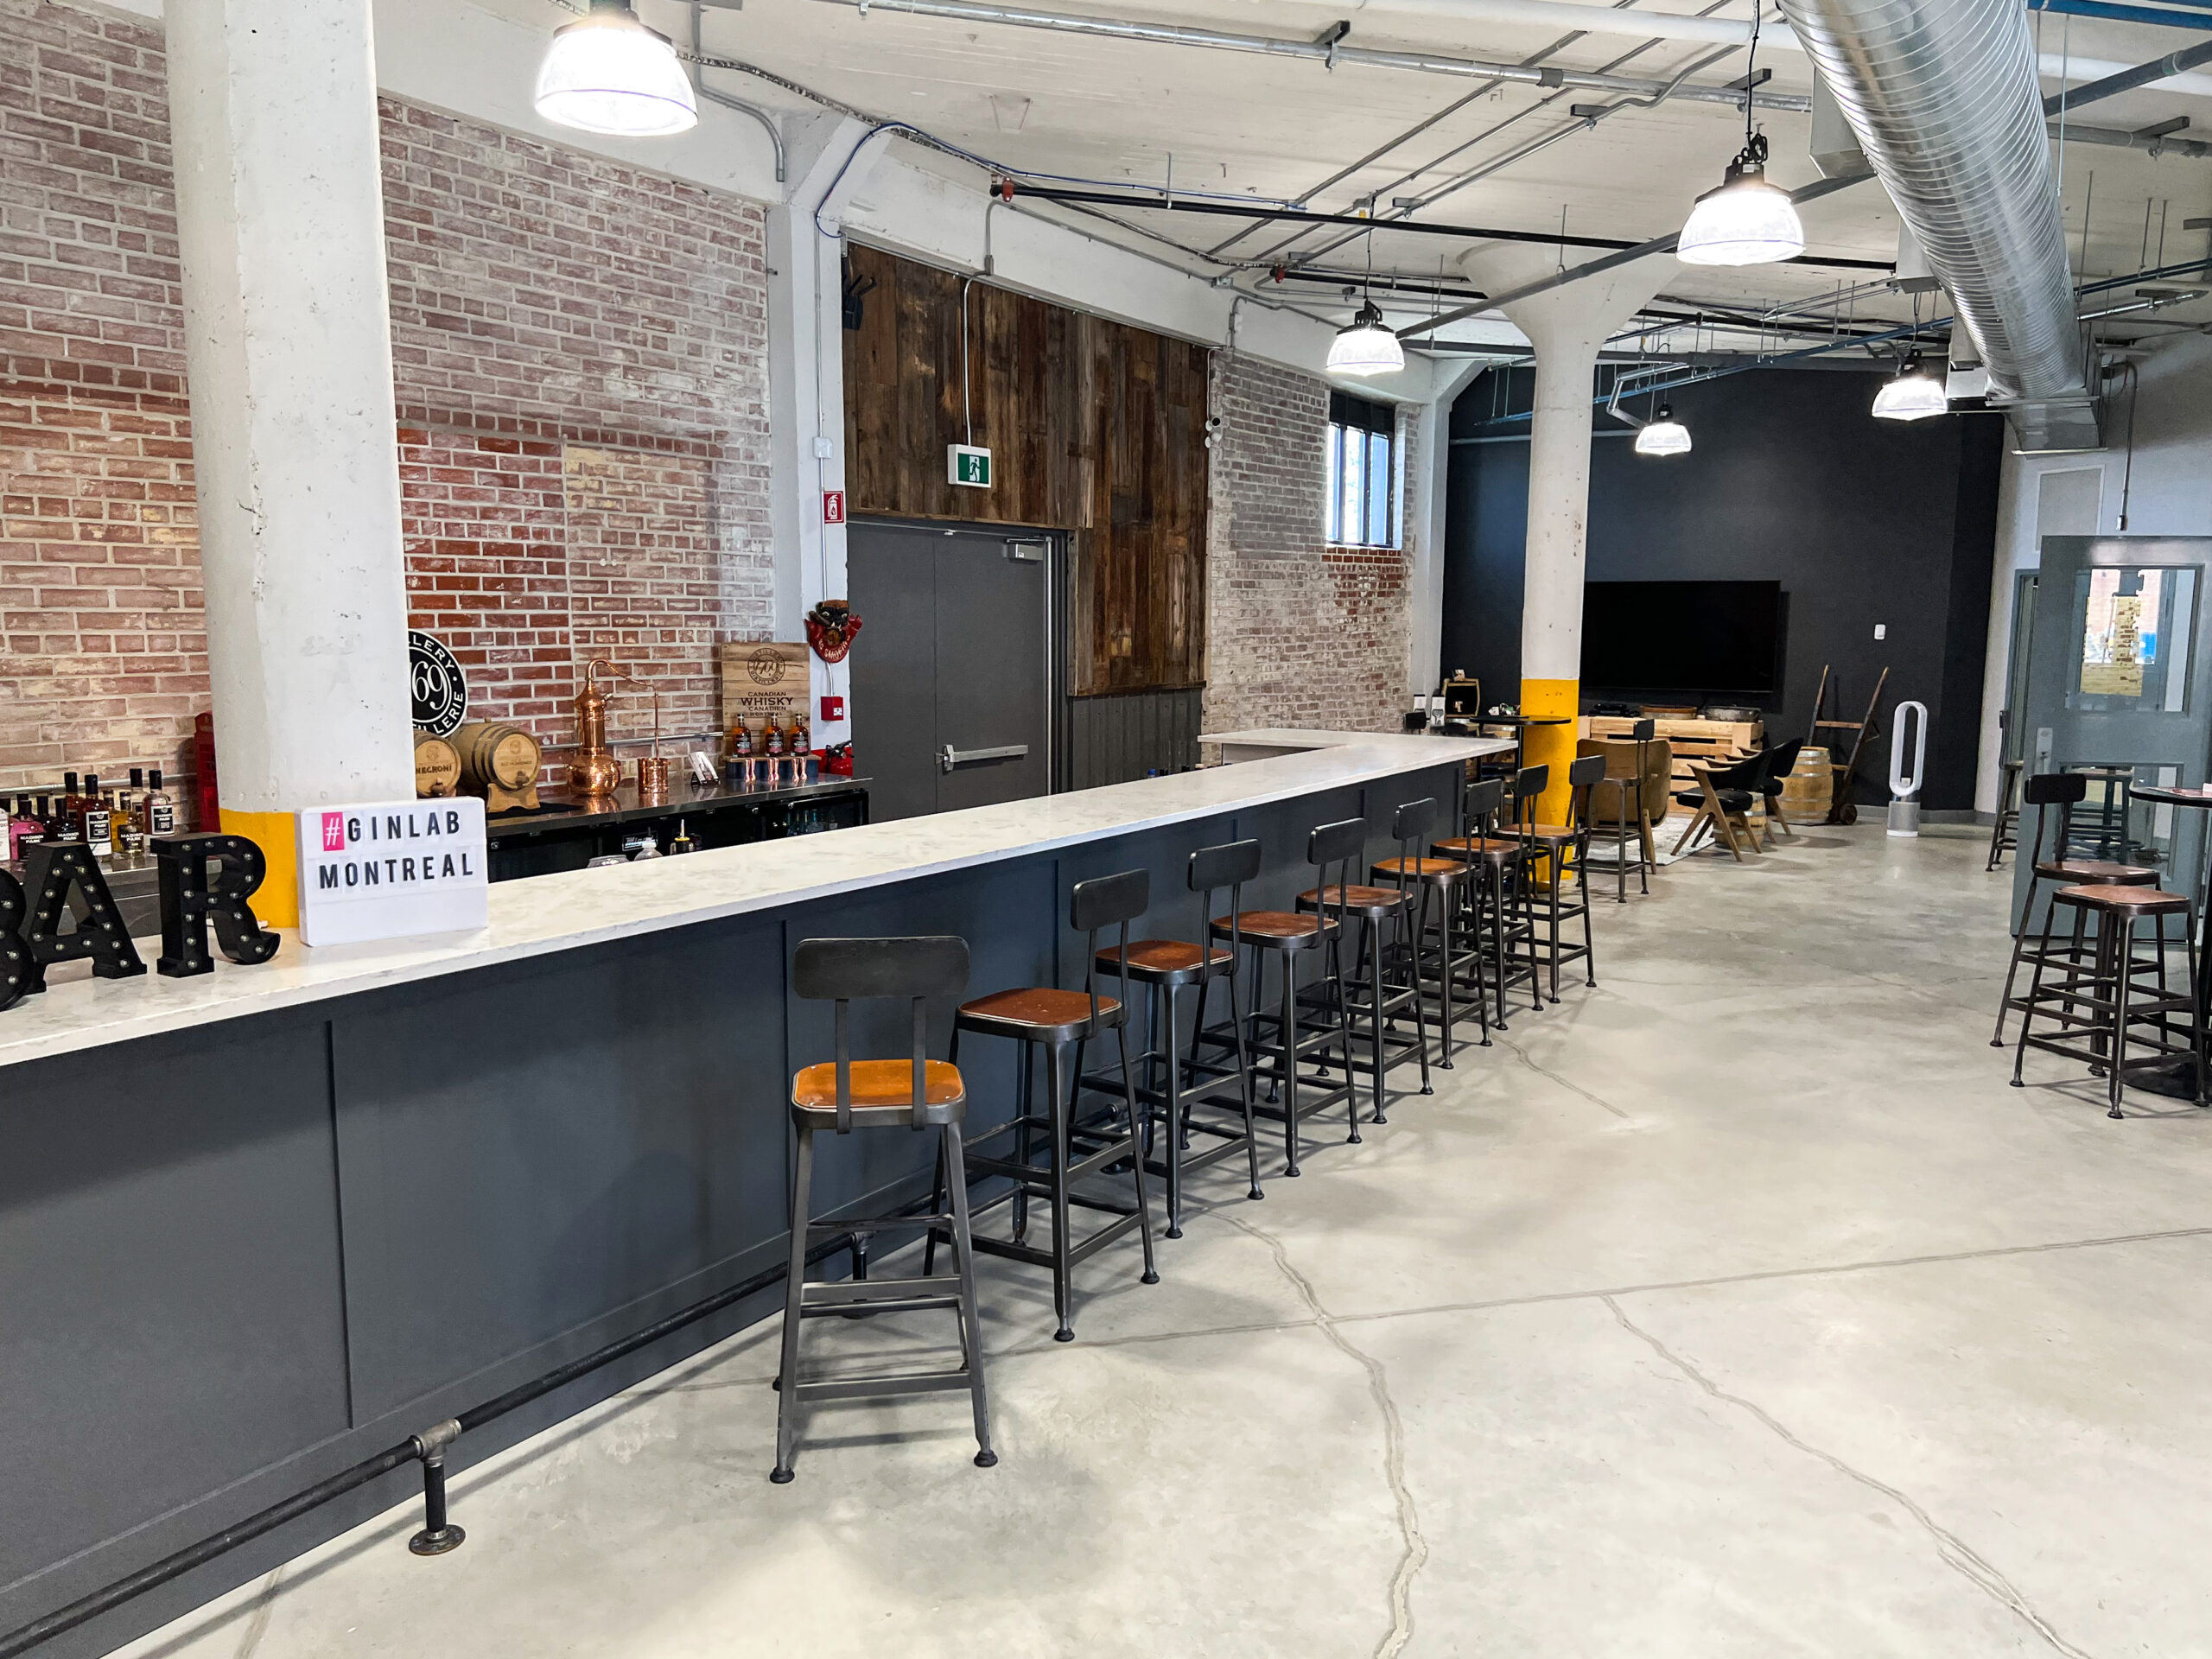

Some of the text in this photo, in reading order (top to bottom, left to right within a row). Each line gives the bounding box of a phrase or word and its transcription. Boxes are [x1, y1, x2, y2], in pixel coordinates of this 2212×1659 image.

[741, 696, 793, 706] WHISKY
[415, 765, 452, 775] NEGRONI
[325, 810, 461, 847] #GINLAB
[319, 852, 474, 889] MONTREAL
